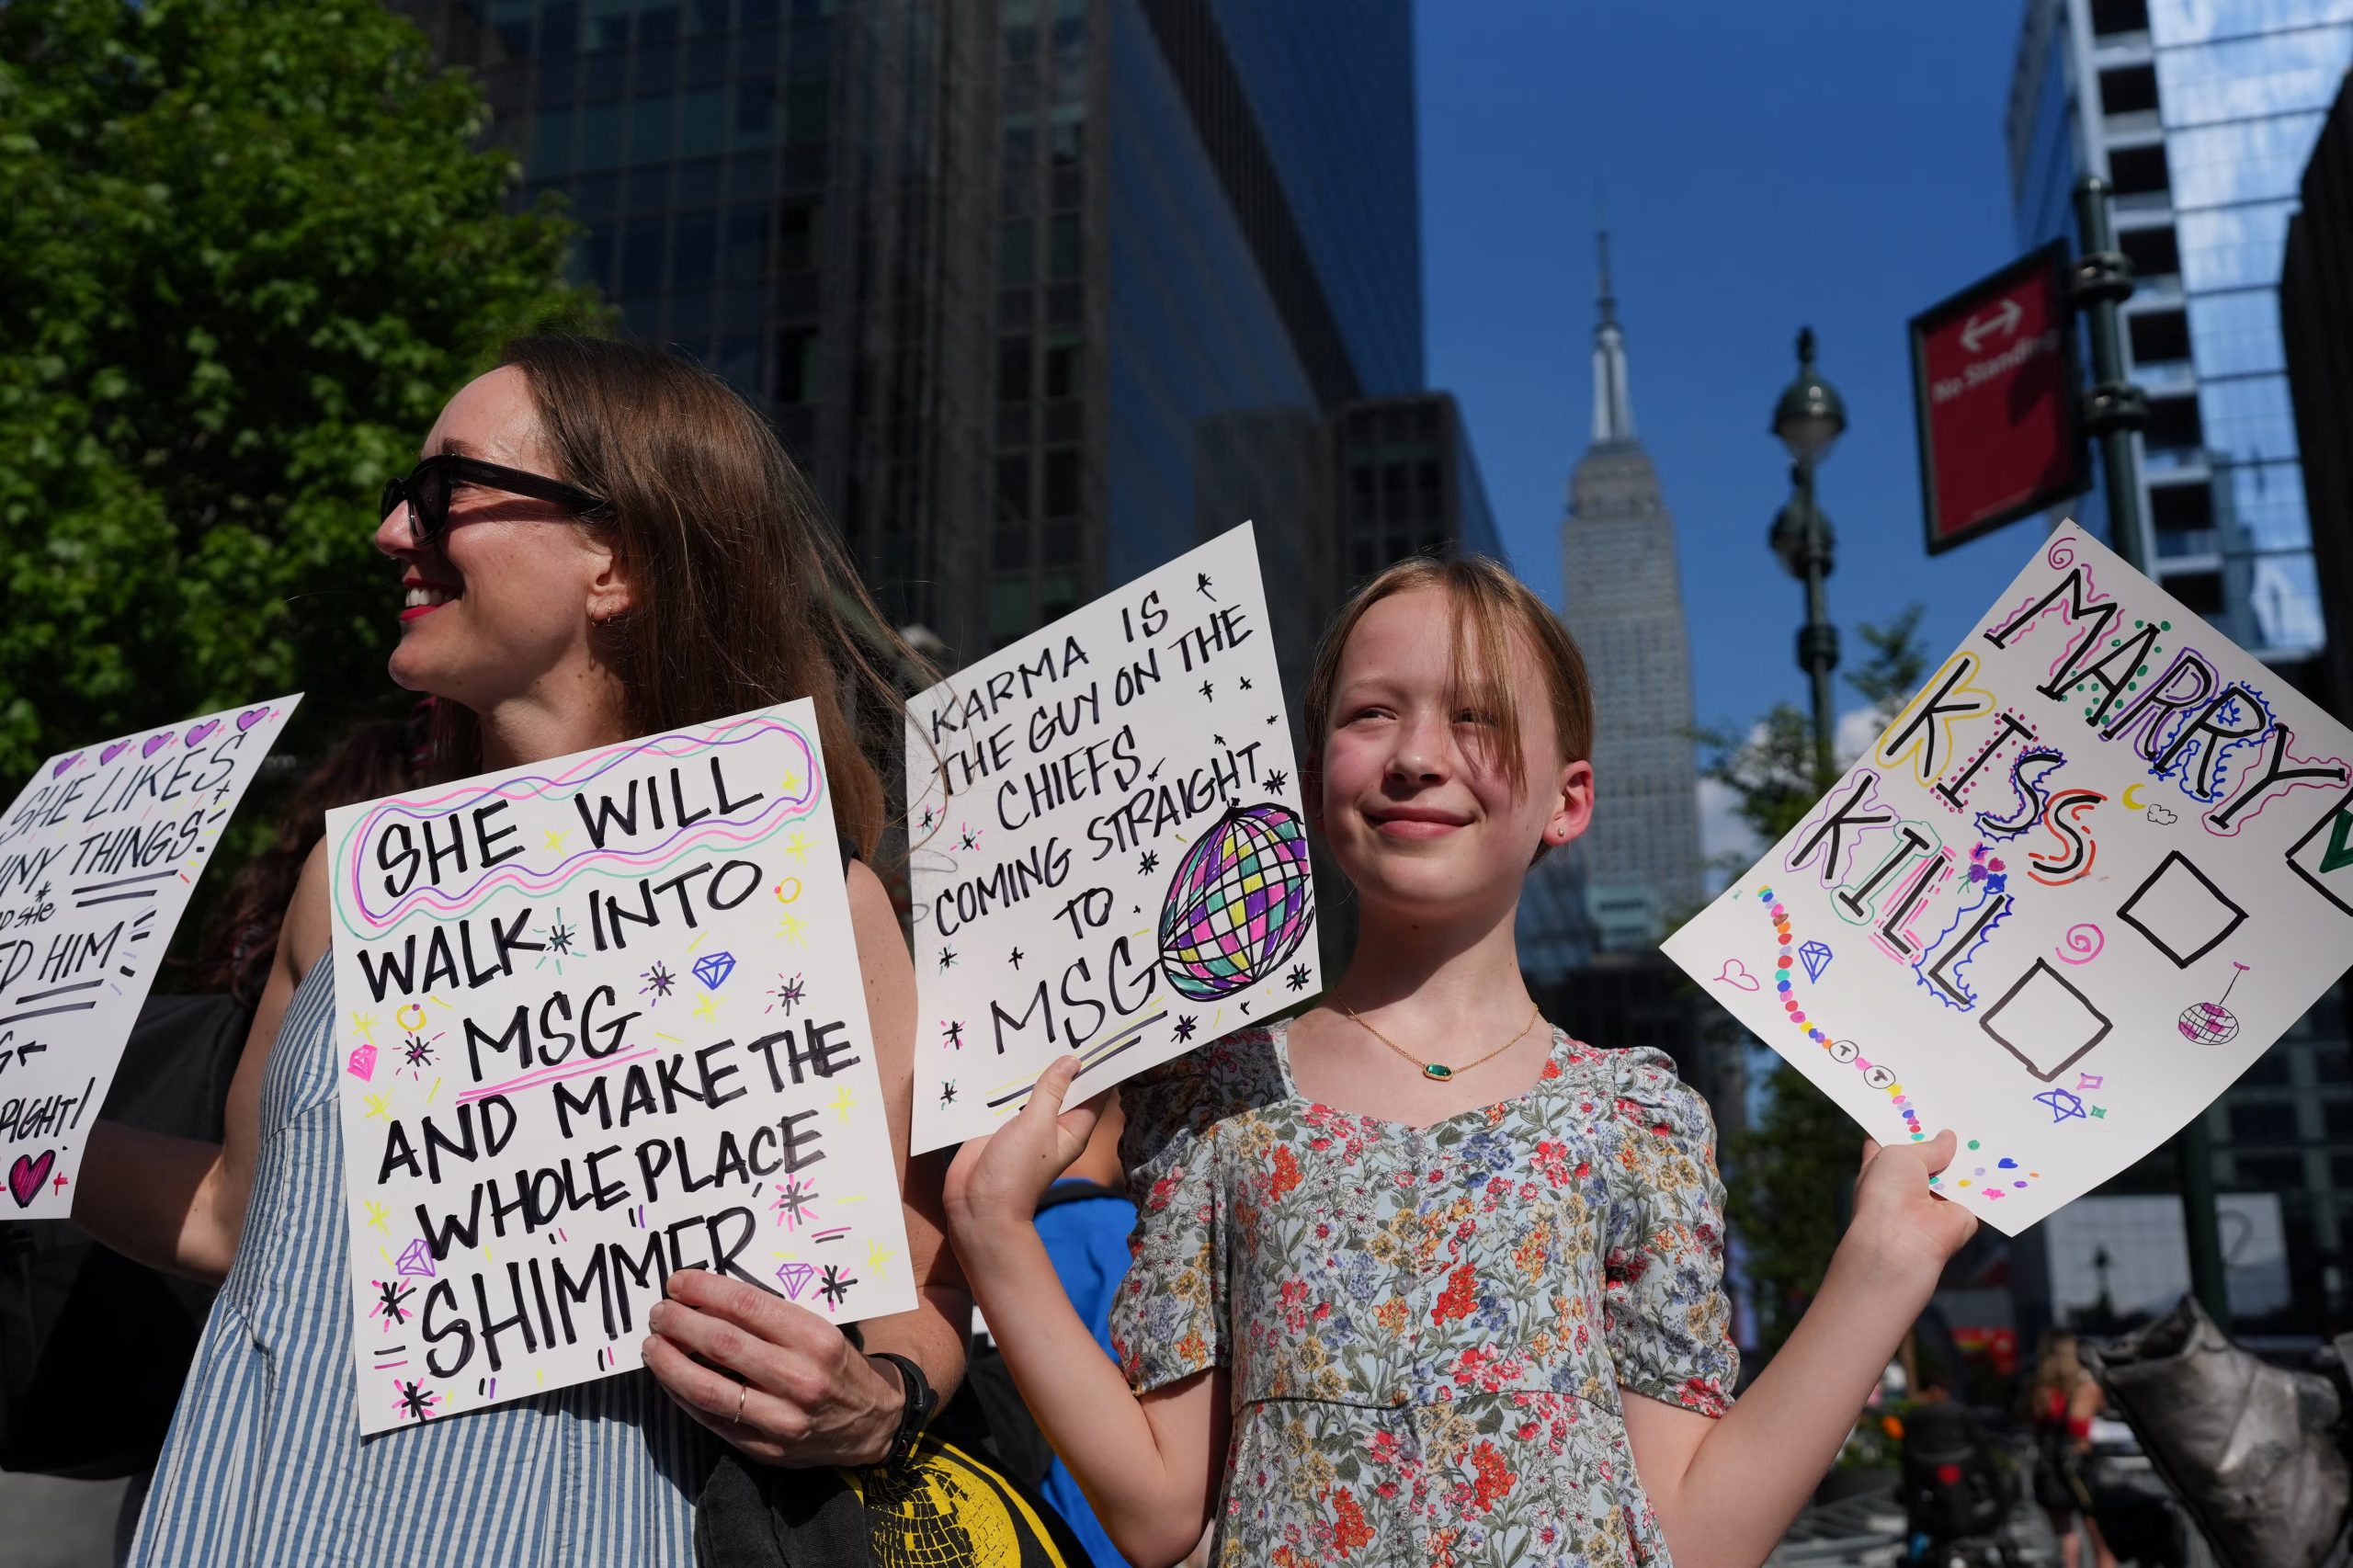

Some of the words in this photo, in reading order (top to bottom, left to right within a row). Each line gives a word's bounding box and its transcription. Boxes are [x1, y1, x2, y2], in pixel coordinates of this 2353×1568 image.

[931, 635, 1090, 744] KARMA
[1120, 590, 1168, 642] IS
[931, 723, 1015, 796] THE
[1029, 682, 1100, 753] GUY
[1115, 648, 1161, 706] ON
[1167, 604, 1254, 672] THE
[1983, 568, 2346, 829] MARRY
[0, 772, 97, 845] SHE
[83, 732, 248, 824] LIKES
[376, 799, 527, 898] SHE
[574, 756, 765, 848] WILL
[936, 837, 1072, 937] COMING
[1087, 742, 1262, 861] STRAIGHT
[997, 724, 1141, 830] CHIEFS
[1886, 657, 2102, 875] KISS
[38, 921, 125, 983] HIM
[357, 907, 548, 1003] WALK
[589, 859, 763, 950] INTO
[1052, 887, 1113, 939] TO
[1790, 776, 2005, 1006] KILL
[462, 985, 642, 1083] MSG
[990, 936, 1161, 1055] MSG
[378, 1094, 517, 1184] AND
[553, 1040, 747, 1139] MAKE
[747, 1018, 861, 1093] THE
[415, 1144, 631, 1261] WHOLE
[635, 1109, 827, 1203] PLACE
[420, 1206, 785, 1378] SHIMMER
